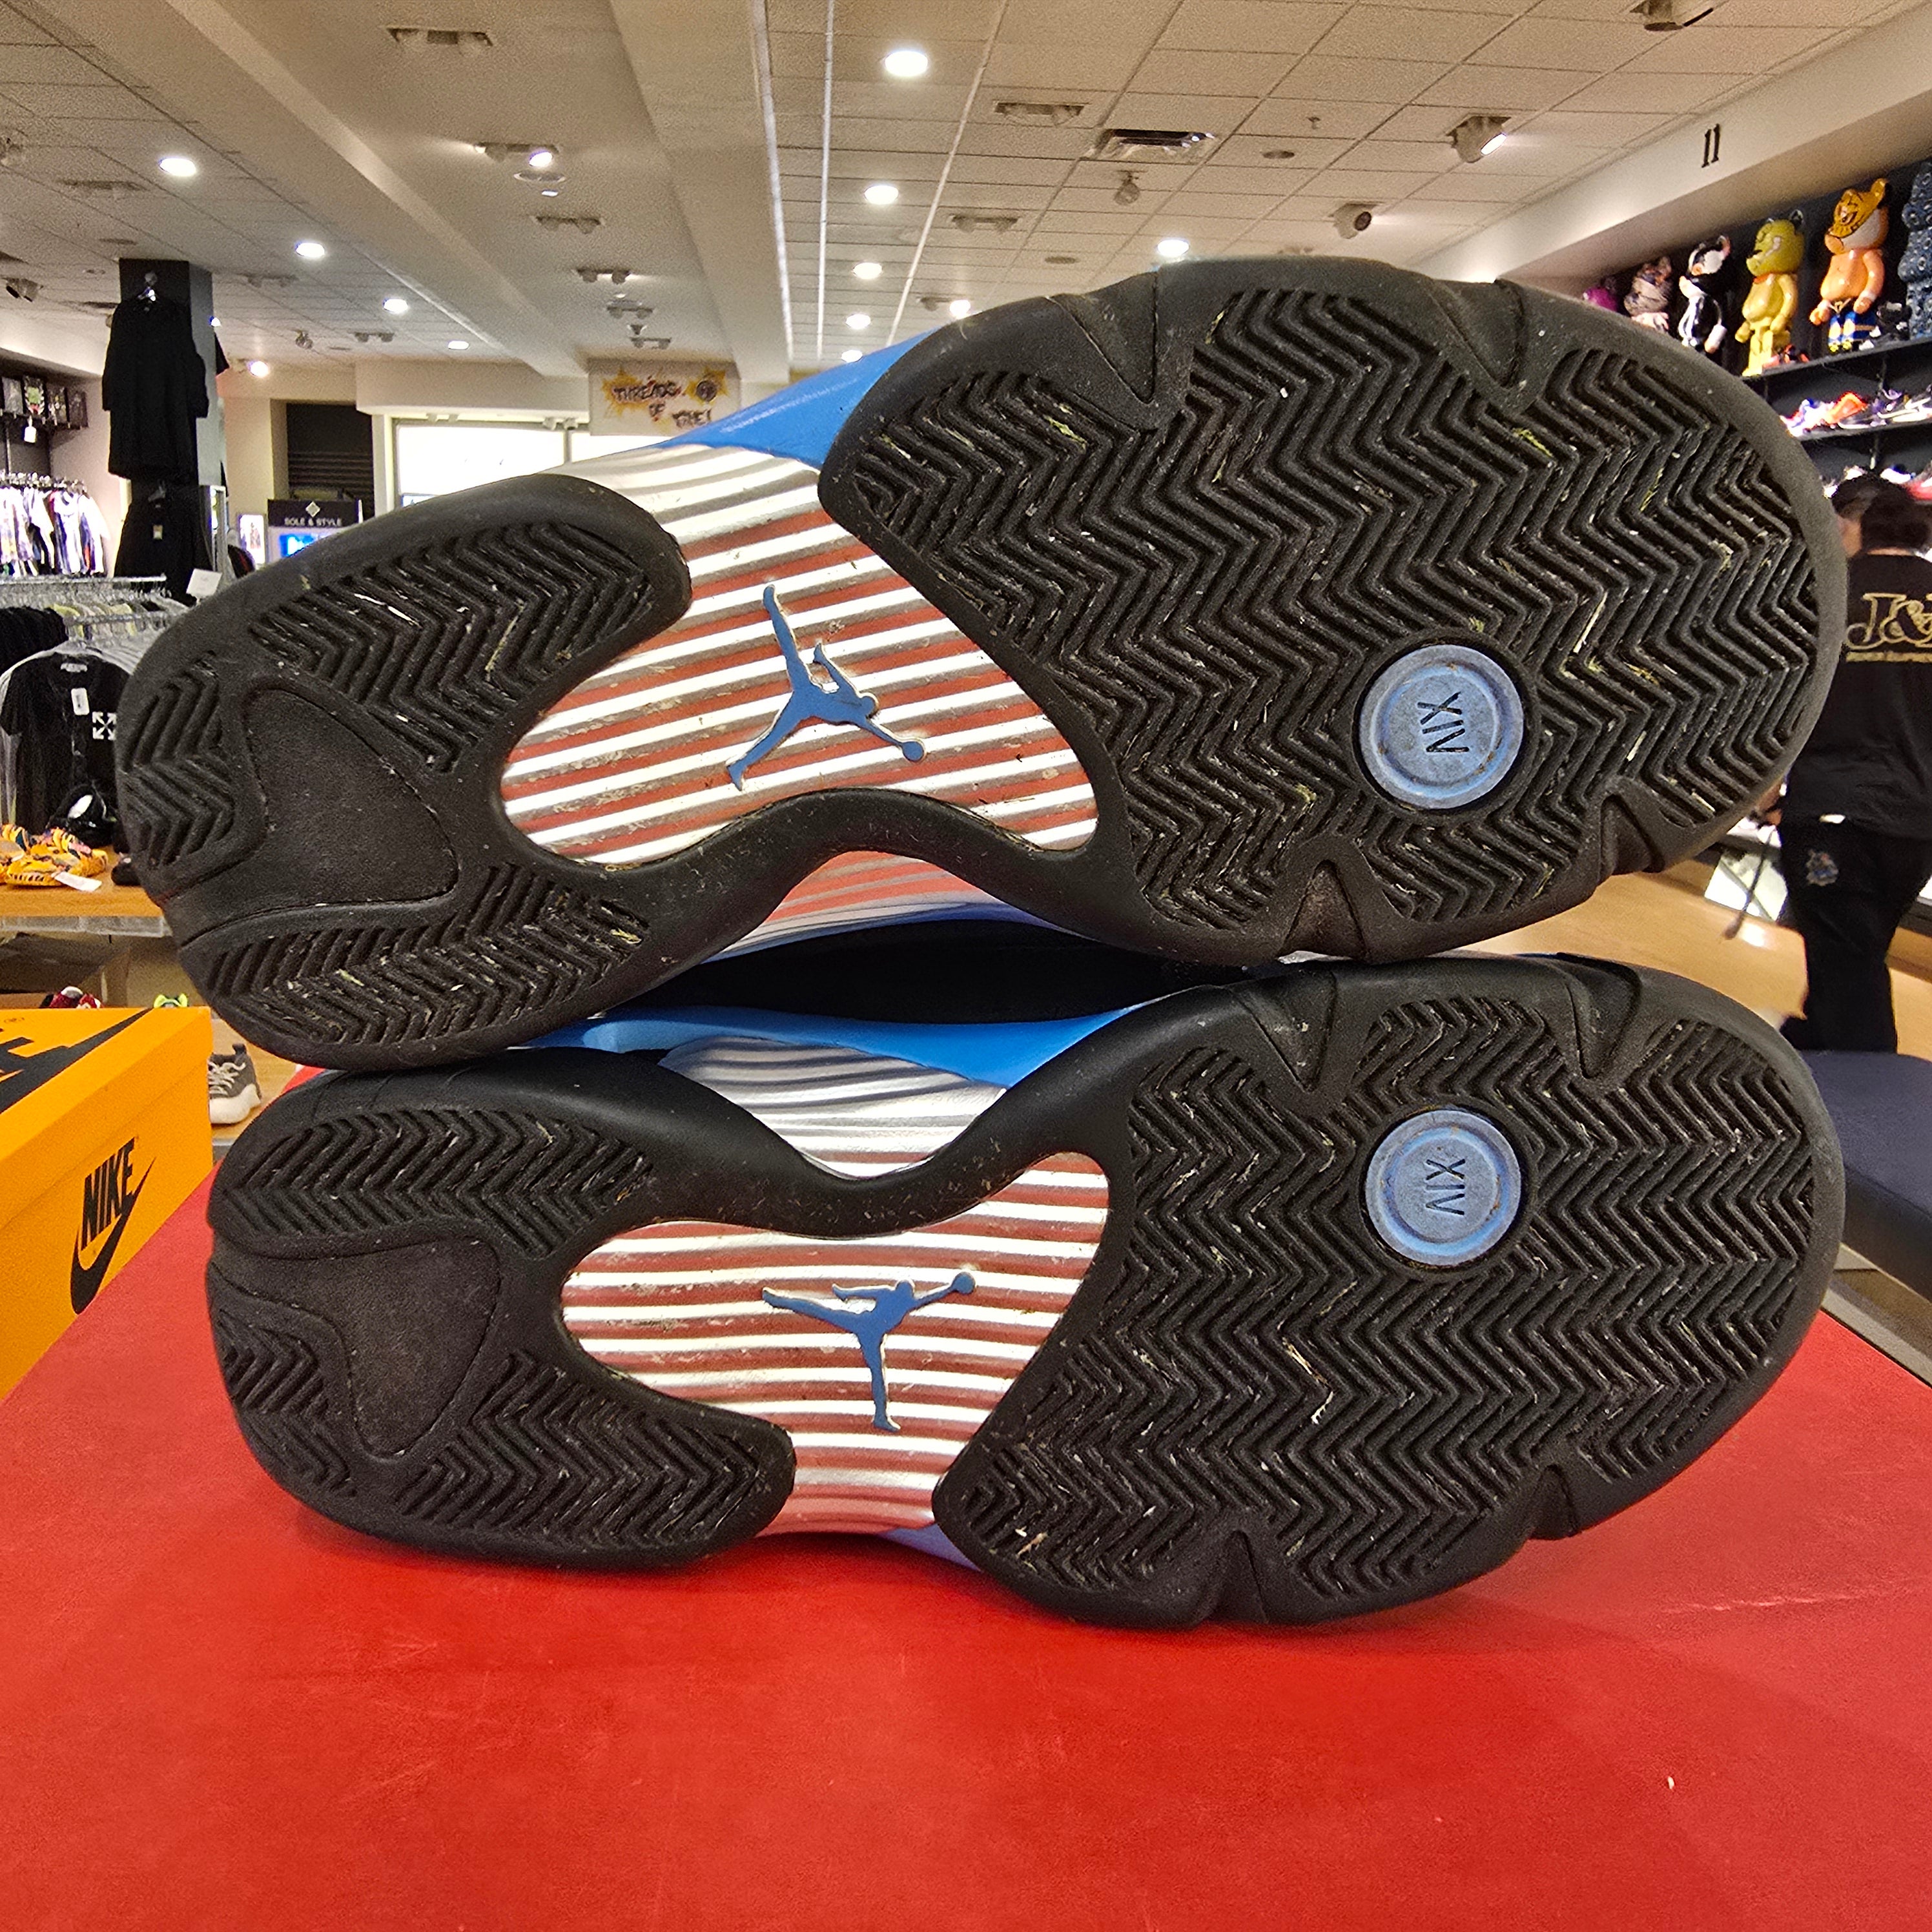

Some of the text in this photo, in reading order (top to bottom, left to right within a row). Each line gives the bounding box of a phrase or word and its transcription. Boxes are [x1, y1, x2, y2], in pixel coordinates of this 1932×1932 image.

[1845, 593, 1932, 650] J&
[1417, 692, 1469, 752] XIV
[81, 1137, 137, 1251] NIKE
[1425, 1159, 1465, 1215] XIV
